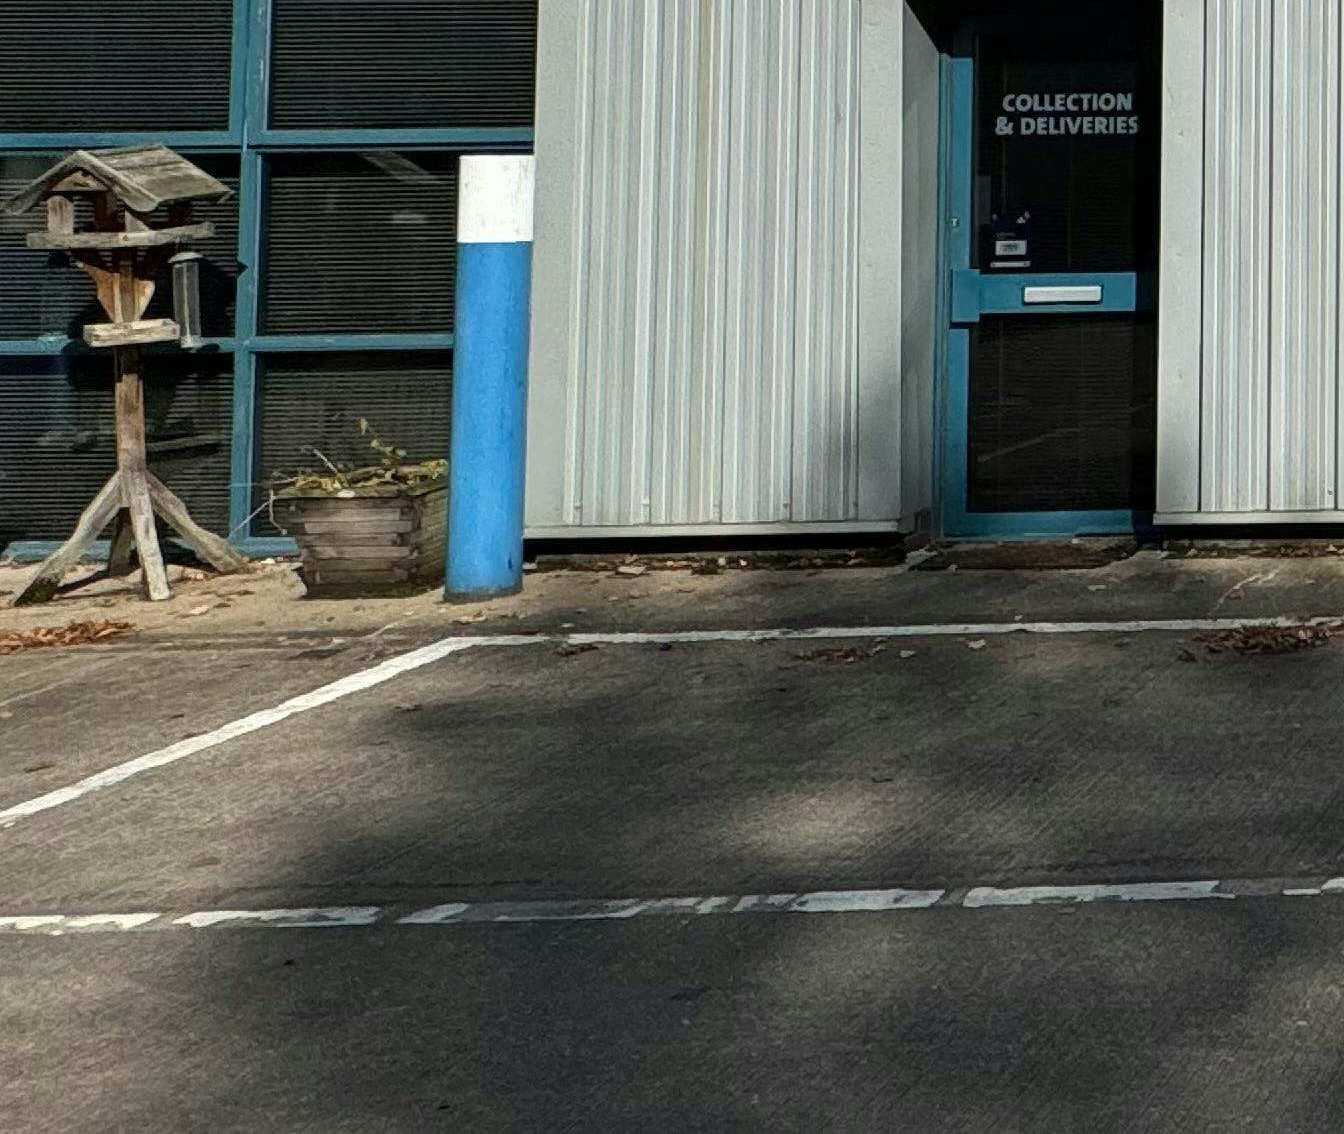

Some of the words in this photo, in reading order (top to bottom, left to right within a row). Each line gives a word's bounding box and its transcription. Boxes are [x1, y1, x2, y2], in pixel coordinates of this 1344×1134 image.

[1002, 93, 1133, 112] COLLECTION
[994, 116, 1014, 136] &
[1020, 115, 1139, 135] DELIVERIES
